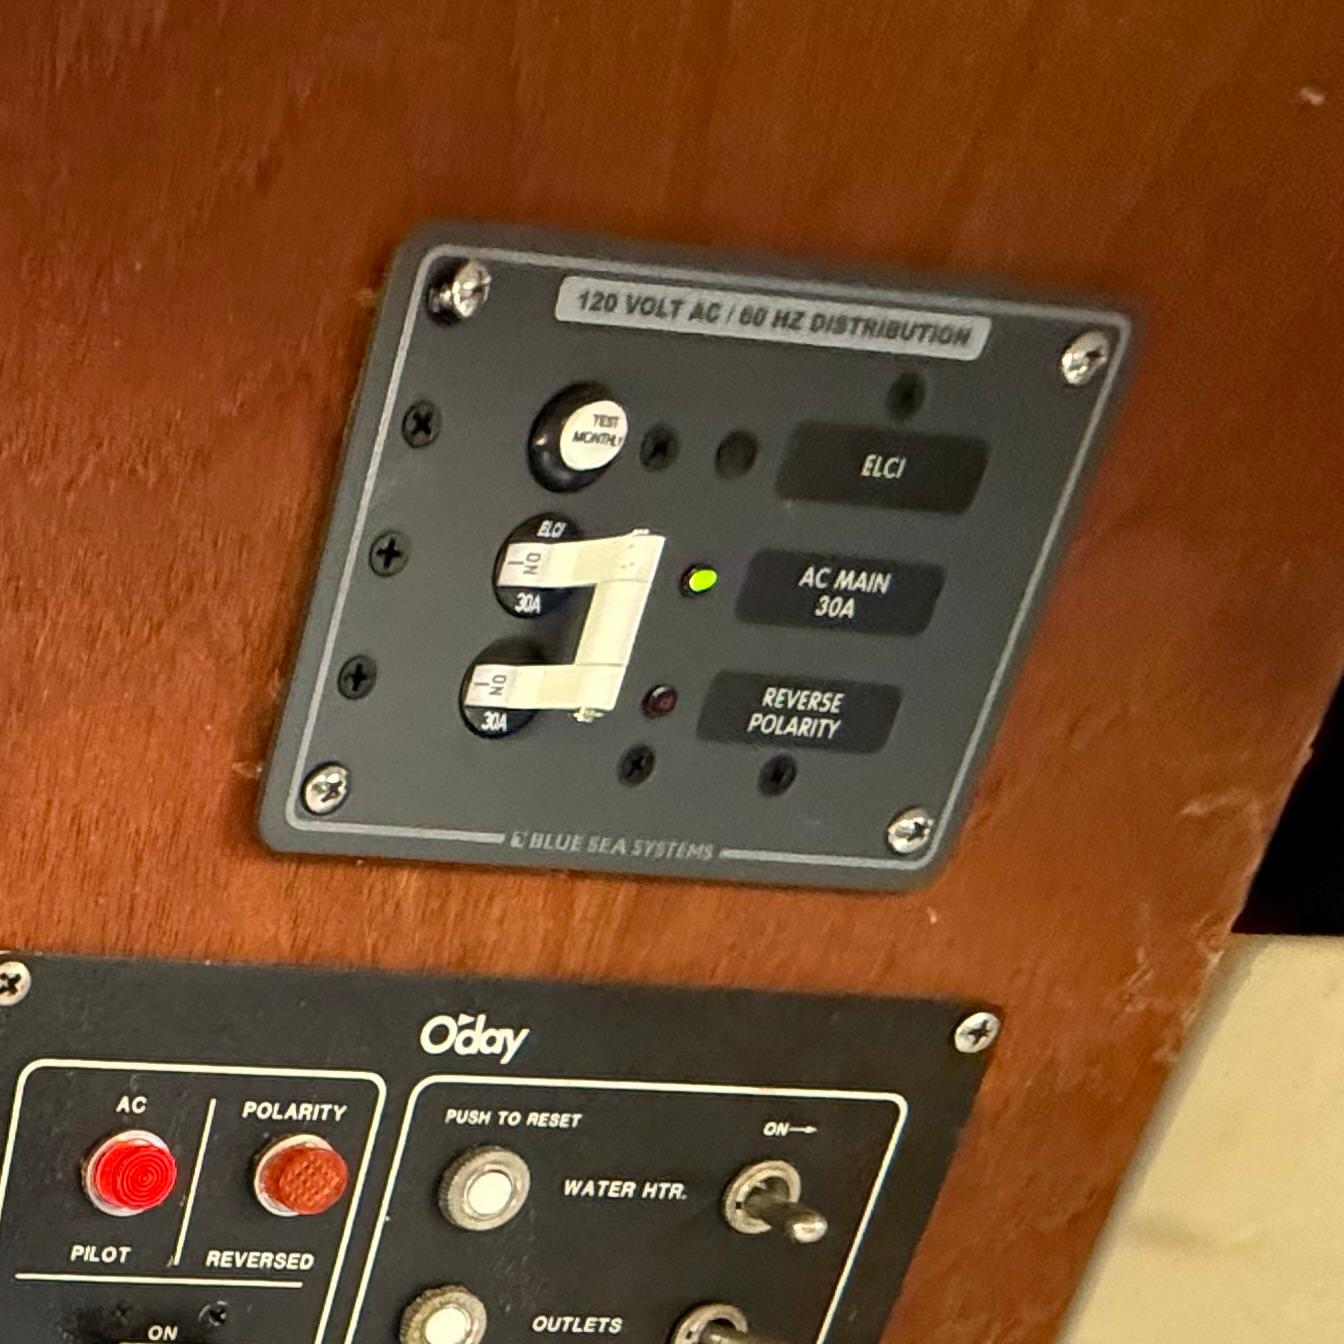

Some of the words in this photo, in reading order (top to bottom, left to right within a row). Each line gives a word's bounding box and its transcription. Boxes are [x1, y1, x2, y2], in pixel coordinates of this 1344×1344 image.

[578, 290, 617, 312] 120
[626, 294, 685, 320] VOLT
[689, 302, 721, 323] AC
[726, 304, 735, 323] /
[739, 307, 765, 327] 60
[772, 310, 803, 331] HZ
[810, 313, 973, 347] DISTRIBUTION
[593, 414, 620, 428] TEST
[572, 431, 623, 447] MONTHLY
[861, 454, 906, 479] ELCI
[522, 552, 541, 575] ON
[799, 567, 831, 589] AC
[834, 570, 891, 594] MAIN
[514, 593, 541, 614] 30A
[815, 597, 855, 619] 30A
[489, 674, 507, 696] ON
[762, 687, 845, 714] REVERSE
[480, 711, 507, 732] 30A
[747, 713, 841, 739] POLARITY
[529, 832, 585, 851] BLUE
[587, 836, 626, 855] SEA
[631, 839, 714, 860] SYSTEMS
[117, 1096, 146, 1114] AC
[242, 1101, 347, 1122] POLARITY
[444, 1109, 492, 1125] PUSH
[498, 1110, 521, 1126] TO
[526, 1112, 583, 1128] RESET
[763, 1121, 790, 1136] ON
[564, 1179, 637, 1198] WATER
[641, 1181, 688, 1200] HTR.
[71, 1245, 132, 1263] PILOT
[206, 1250, 315, 1270] REVERSED
[148, 1325, 178, 1341] ON
[532, 1315, 624, 1334] OUTLETS
